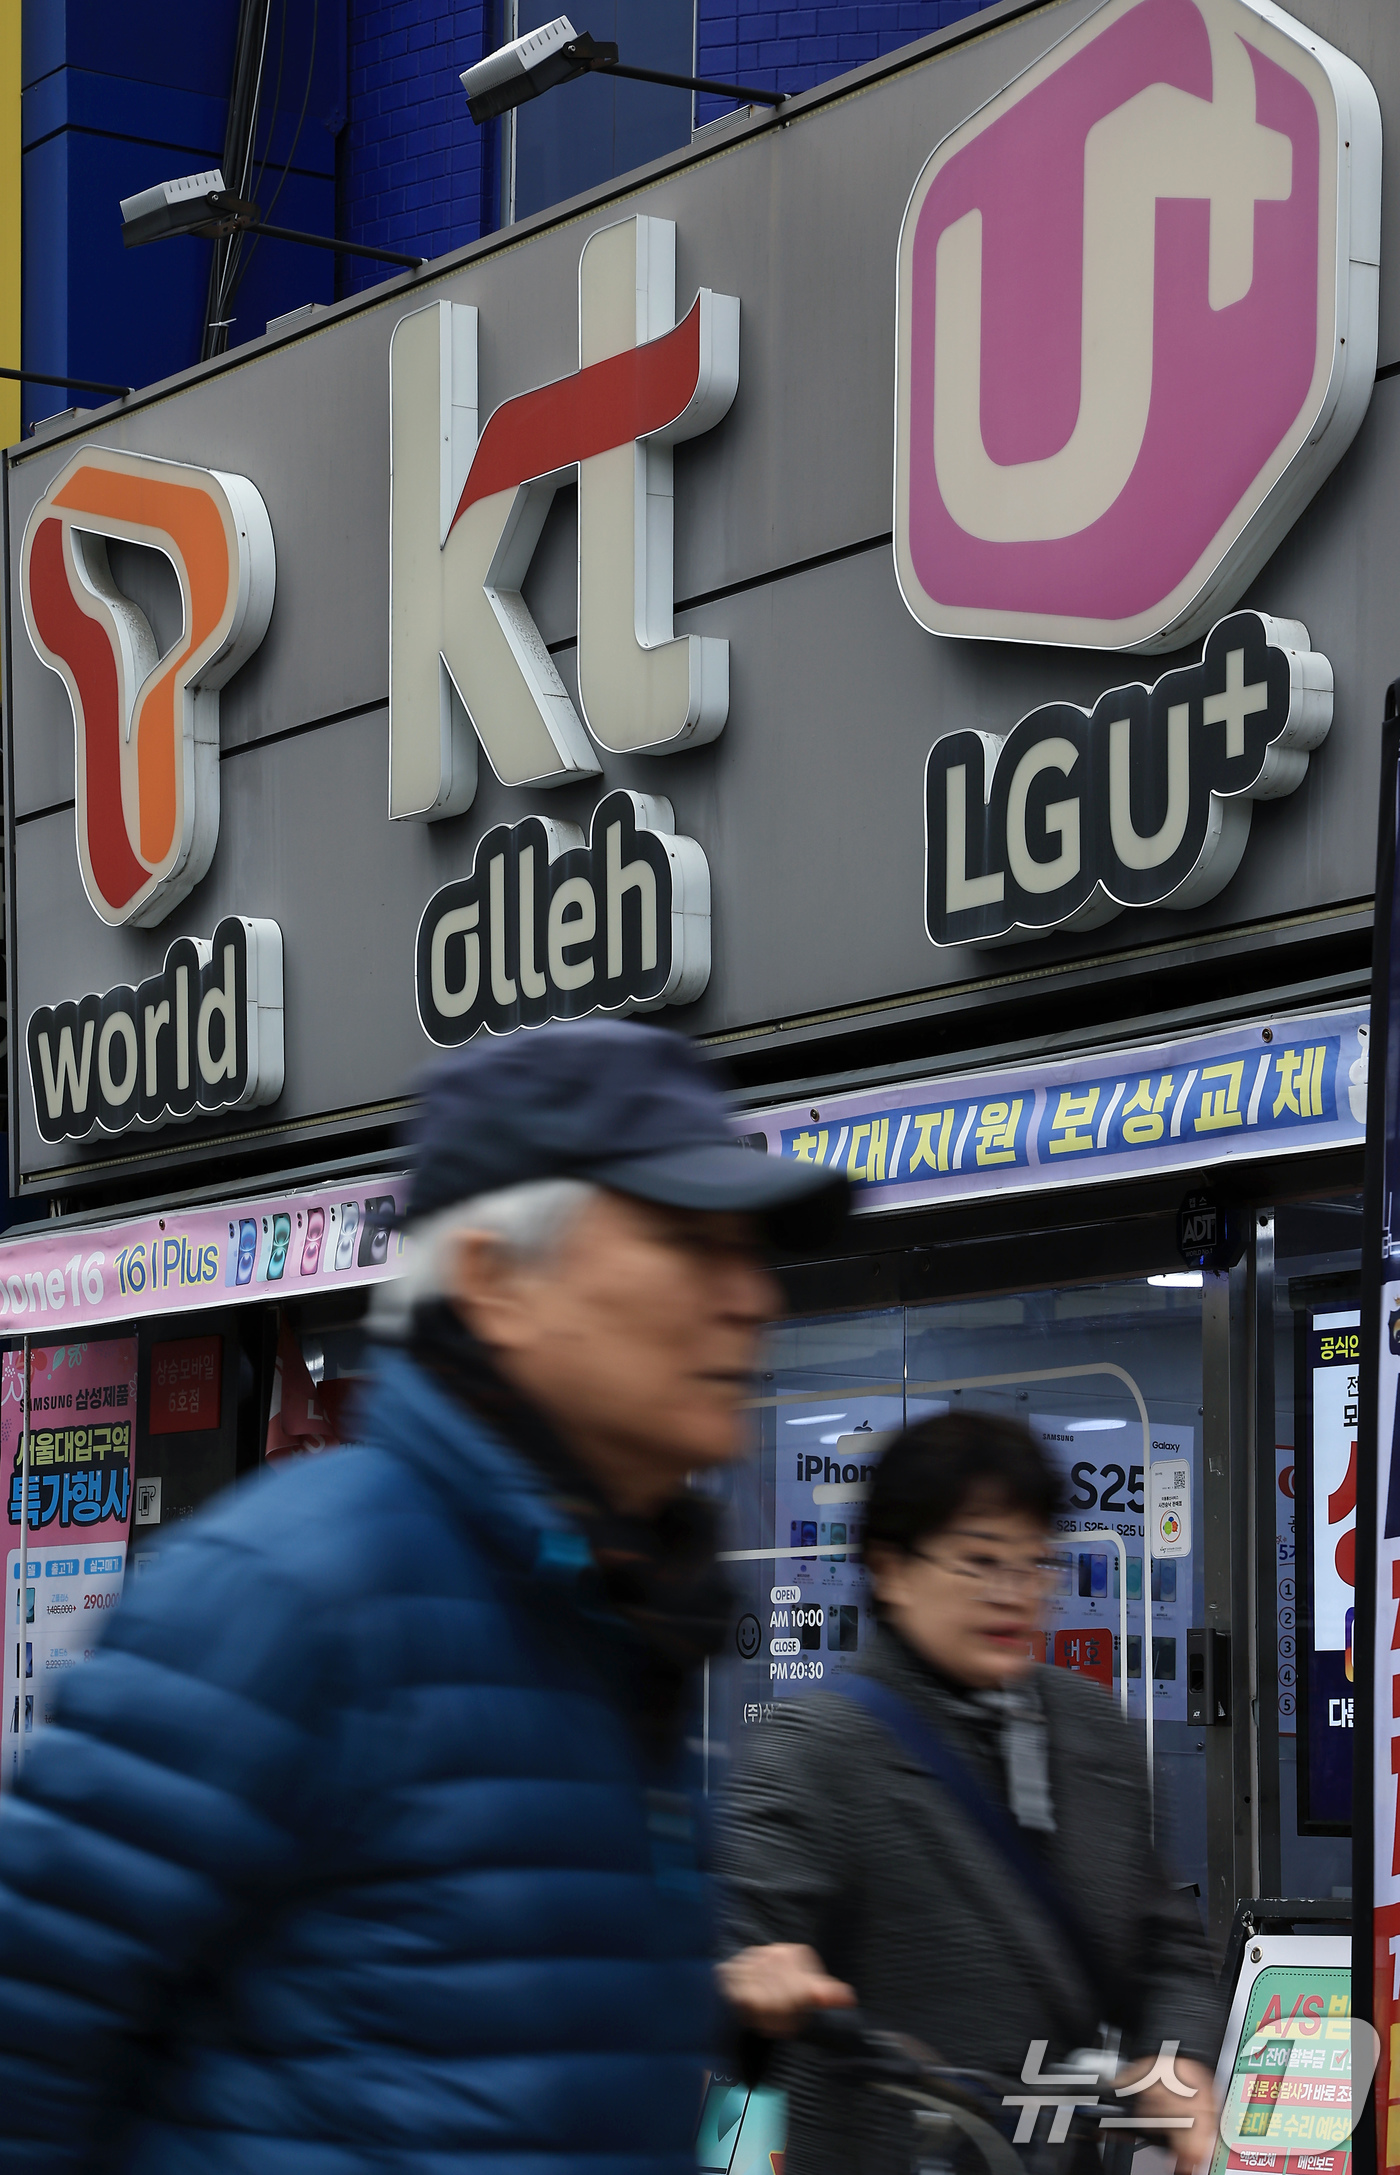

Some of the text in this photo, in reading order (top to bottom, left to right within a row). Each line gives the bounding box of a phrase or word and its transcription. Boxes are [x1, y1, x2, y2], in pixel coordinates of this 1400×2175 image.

[389, 214, 705, 820] kt
[946, 649, 1268, 914] LGU+
[38, 944, 236, 1120] world
[1182, 1212, 1216, 1243] ADT
[156, 1354, 214, 1386] 상승모바일
[75, 1384, 129, 1411] 삼성제품
[169, 1388, 200, 1414] 6호점
[16, 1425, 129, 1466] 서울대입구역
[1042, 1433, 1074, 1442] SAMSUNG
[1152, 1441, 1180, 1453] Galaxy
[797, 1453, 879, 1483] iPhon
[10, 1467, 130, 1526] 특가행사
[1069, 1461, 1144, 1514] S25
[1117, 1524, 1136, 1536] S25
[51, 1562, 73, 1575] 출고가
[90, 1558, 119, 1572] 실구매가
[775, 1589, 796, 1601] OPEN
[769, 1609, 824, 1628] AM 10:00
[774, 1641, 797, 1652] CLOSE
[769, 1662, 788, 1680] PM
[789, 1661, 824, 1680] 20:30
[1256, 1994, 1324, 2038] A/S
[1265, 2047, 1326, 2069] 잔여할부금
[1297, 2155, 1335, 2171] 메인보드
